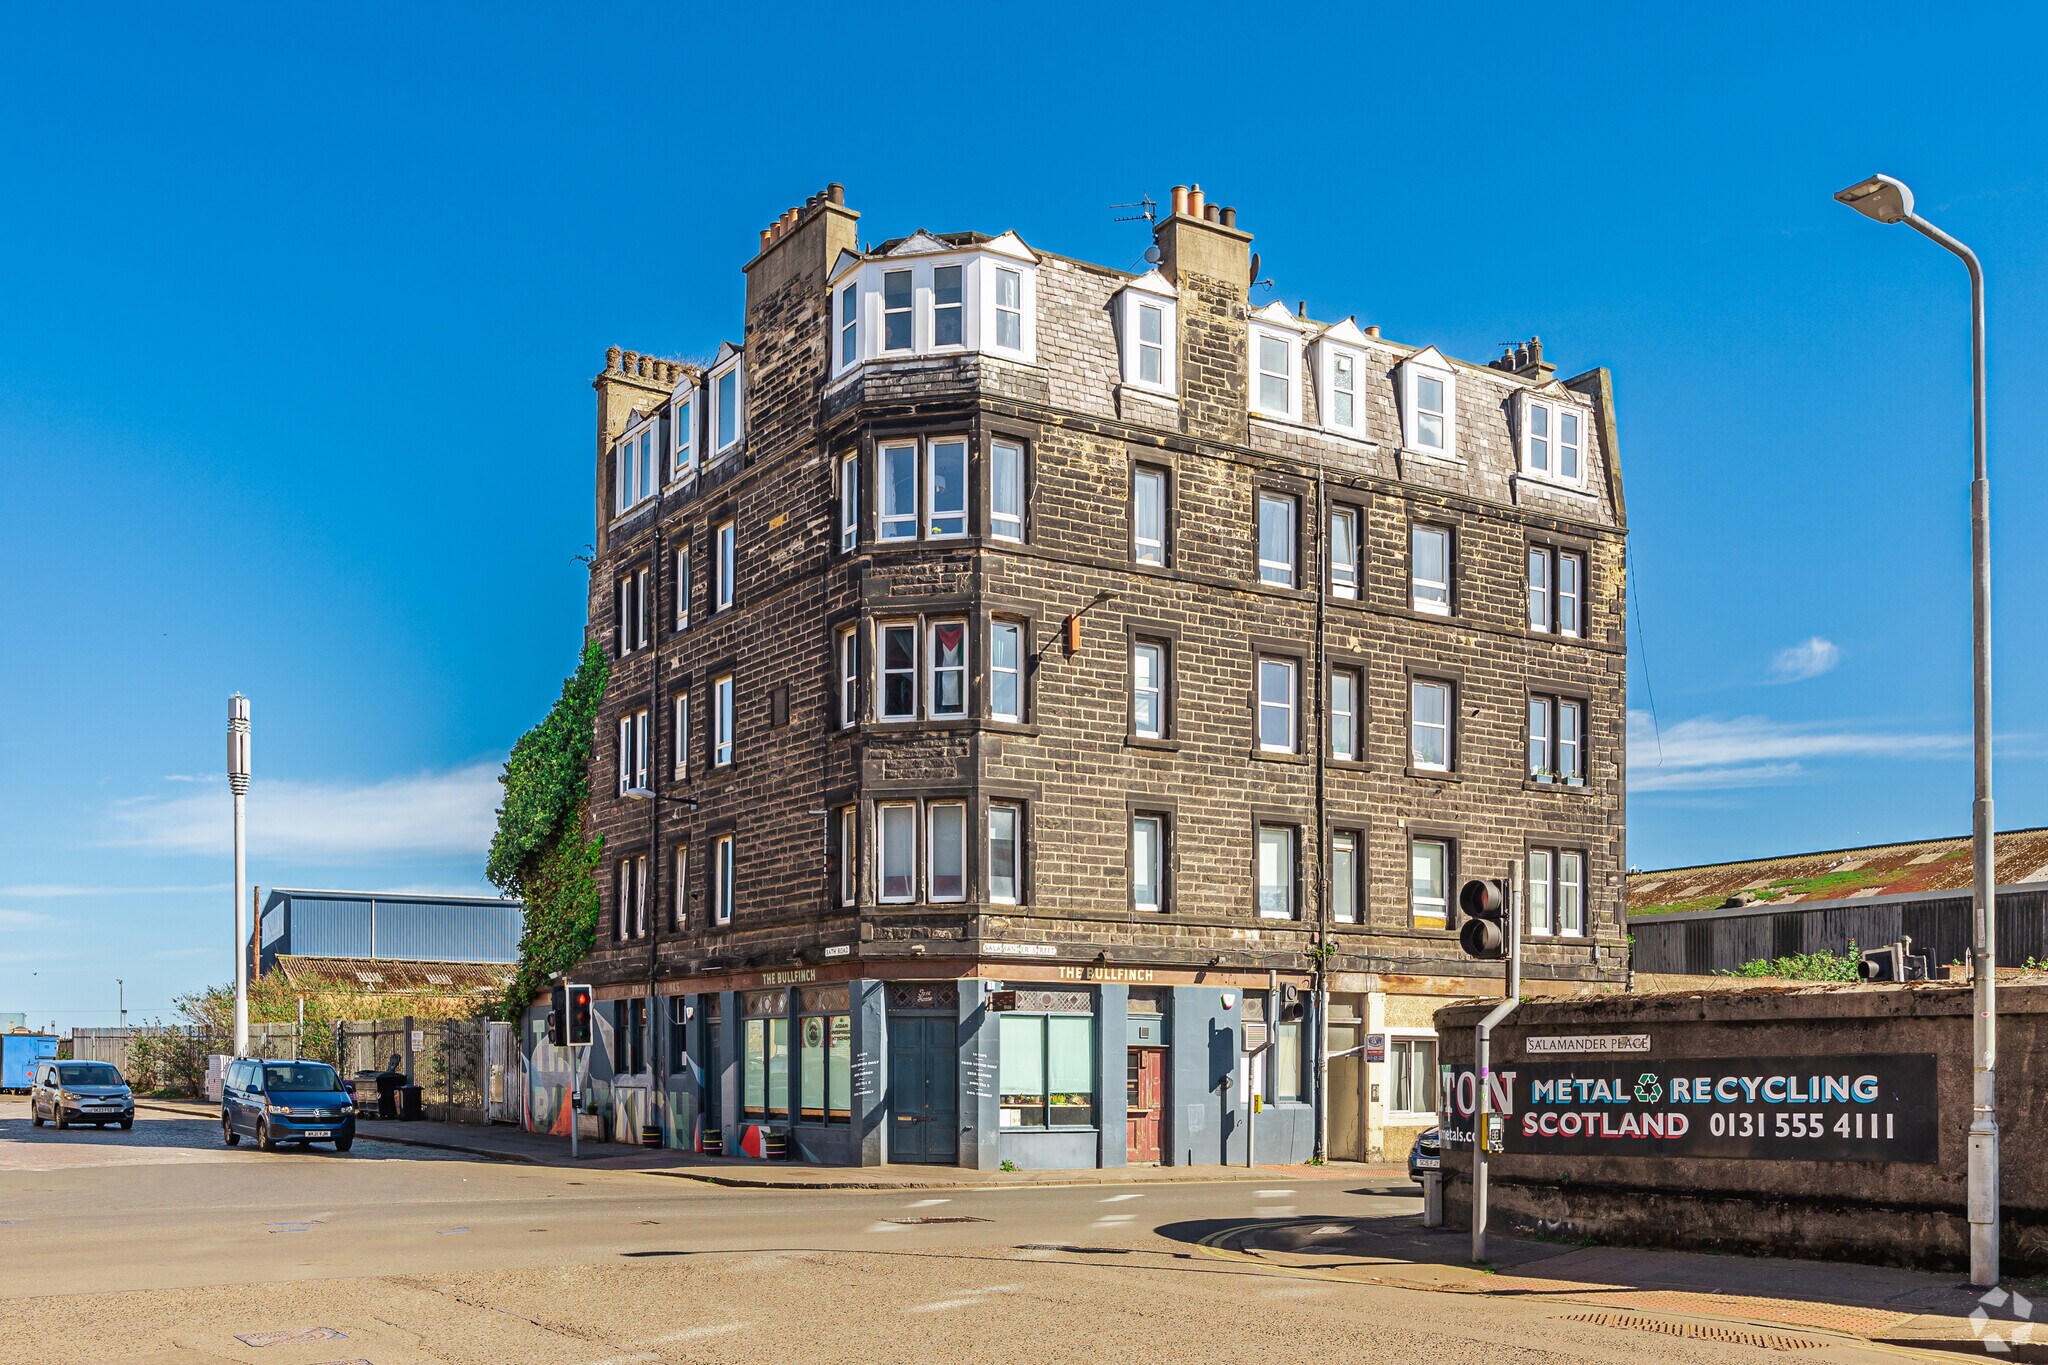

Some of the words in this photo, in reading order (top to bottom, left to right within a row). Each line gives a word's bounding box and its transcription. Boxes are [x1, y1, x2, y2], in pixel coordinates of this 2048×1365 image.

[838, 946, 849, 954] ROAD
[984, 944, 1029, 953] SALAMANDER
[1032, 946, 1055, 954] STREET
[762, 973, 776, 985] THE
[777, 969, 816, 984] BULLFINCH
[1058, 966, 1082, 979] THE
[1086, 966, 1153, 981] BULLFINCH
[1528, 1038, 1607, 1050] SALAMANDER
[1610, 1037, 1648, 1049] PLACE
[1531, 1078, 1632, 1104] METAL
[1669, 1075, 1879, 1104] RECYCLING
[1522, 1111, 1690, 1139] SCOTLAND
[1709, 1112, 1765, 1137] 0131
[1775, 1112, 1825, 1138] 555
[1833, 1112, 1894, 1139] 4111
